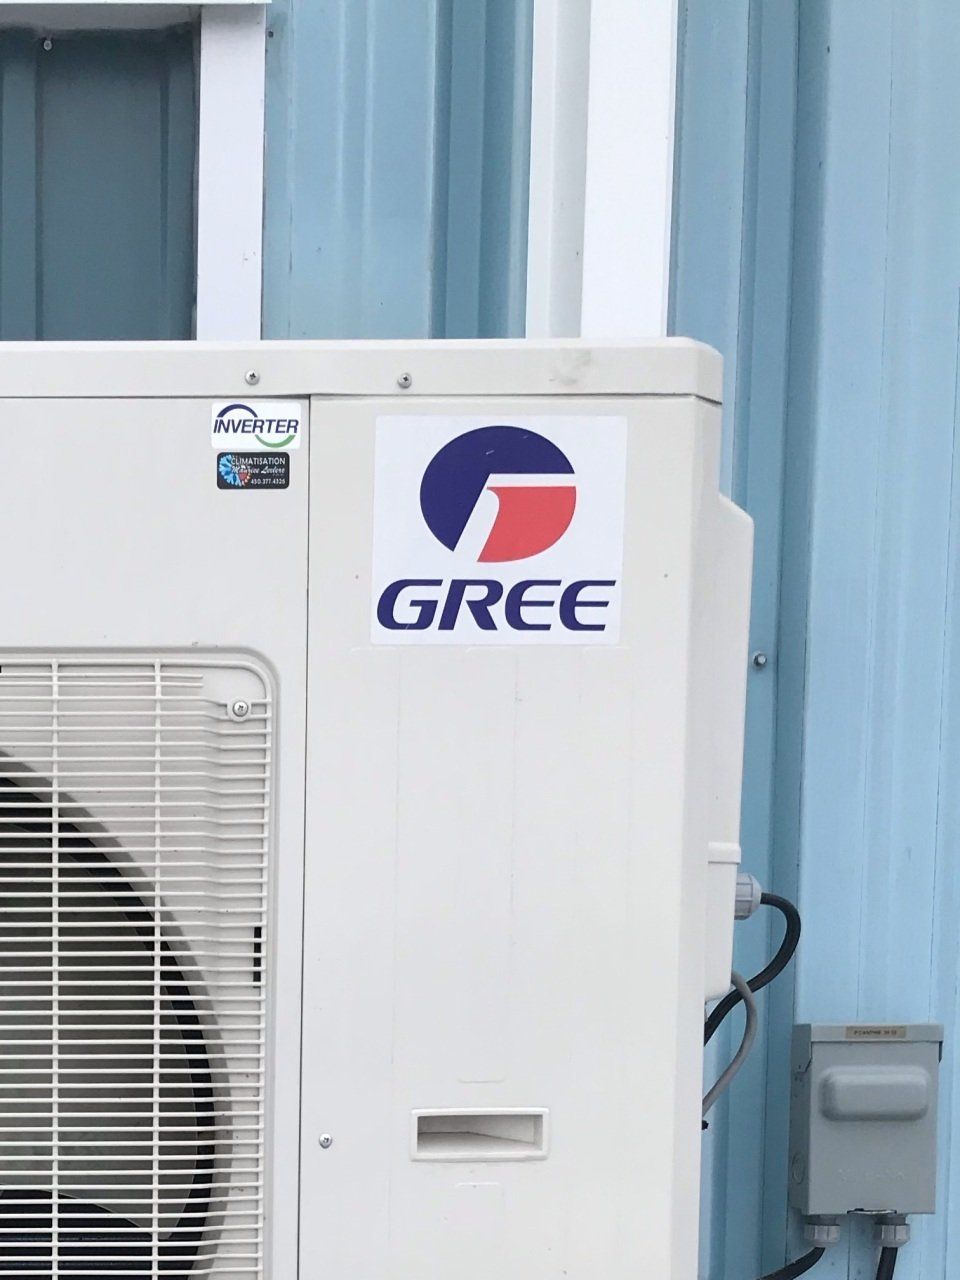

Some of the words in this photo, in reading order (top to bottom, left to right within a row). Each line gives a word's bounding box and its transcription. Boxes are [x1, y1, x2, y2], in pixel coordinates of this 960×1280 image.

[213, 419, 299, 433] INVERTER
[230, 457, 286, 465] CLIMATISATION
[377, 579, 617, 631] GREE
